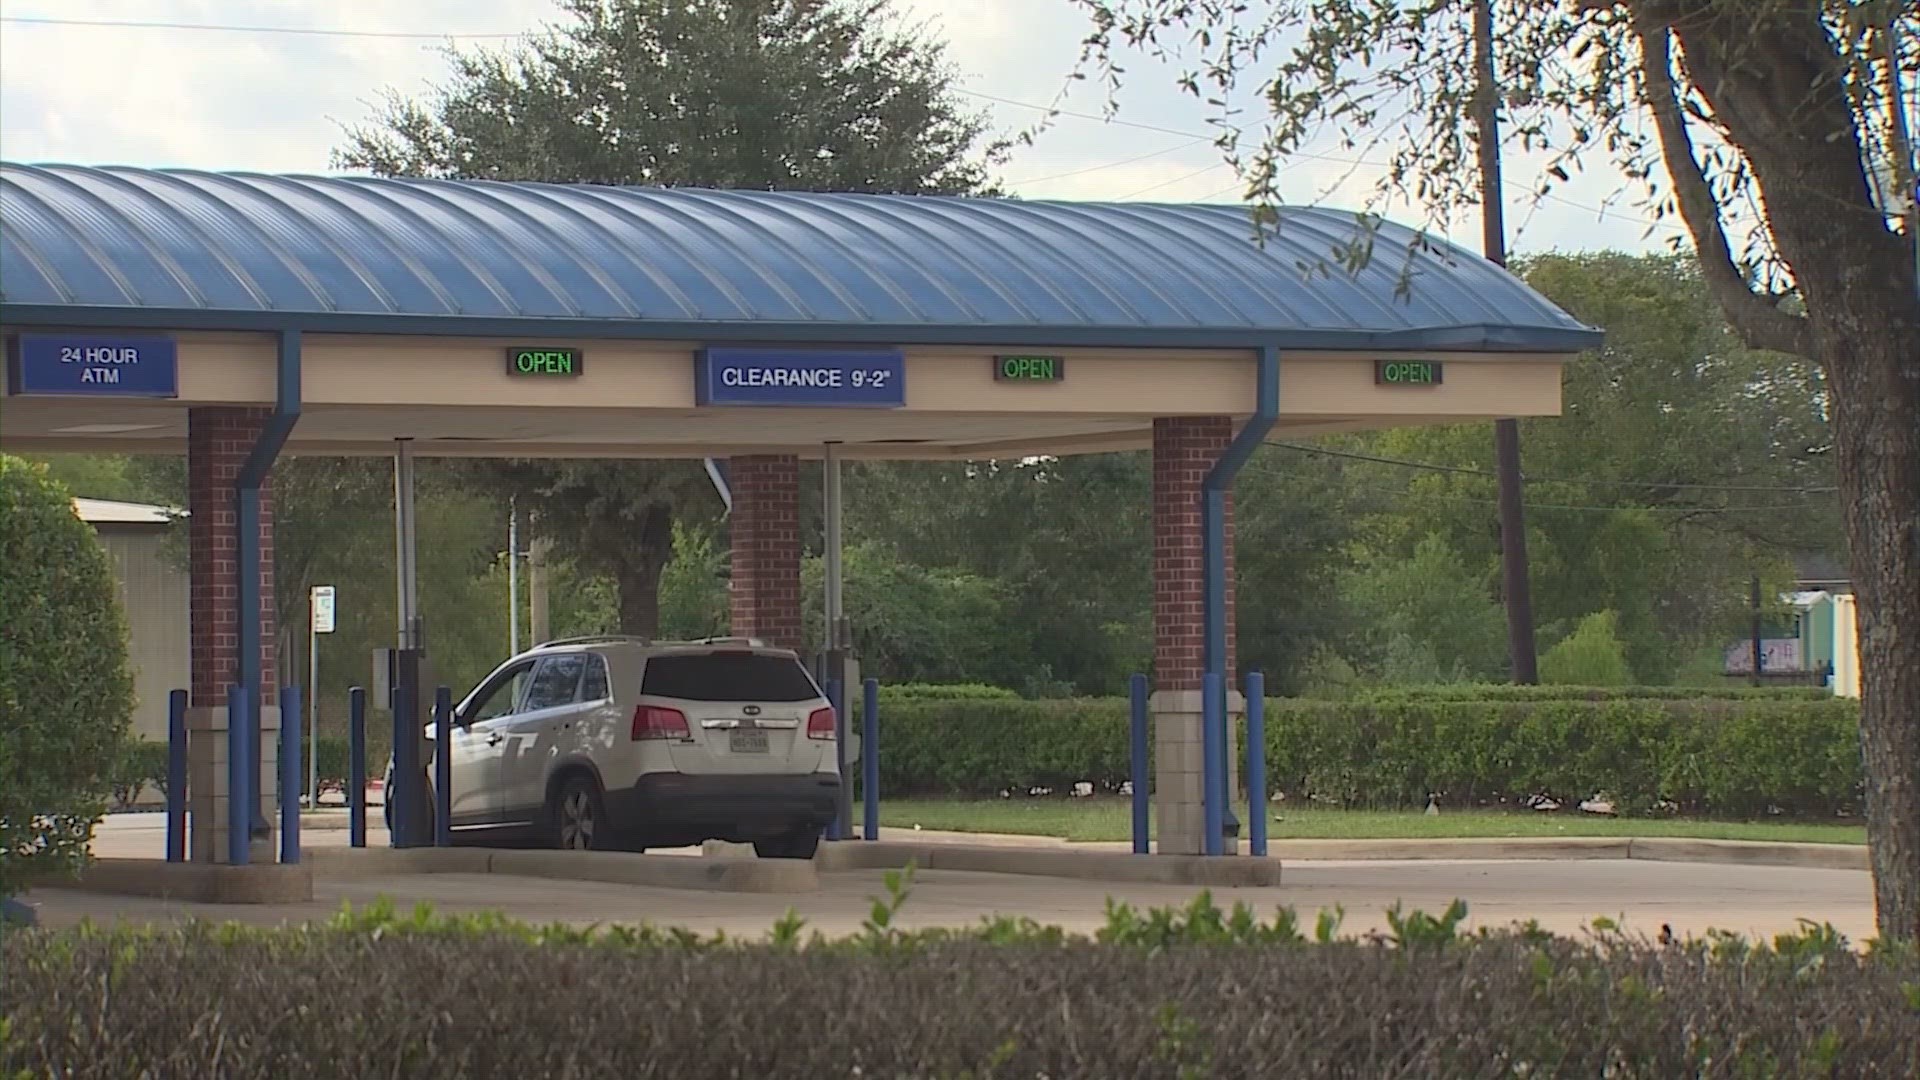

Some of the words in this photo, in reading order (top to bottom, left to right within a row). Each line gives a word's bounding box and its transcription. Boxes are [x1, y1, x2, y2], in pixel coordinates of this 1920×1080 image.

[61, 347, 82, 363] 24
[86, 348, 138, 364] HOUR
[517, 352, 572, 373] OPEN
[81, 367, 119, 384] ATM
[722, 367, 842, 387] CLEARANCE
[851, 370, 891, 388] 9'-2"
[1004, 359, 1054, 379] OPEN
[1385, 363, 1432, 383] OPEN
